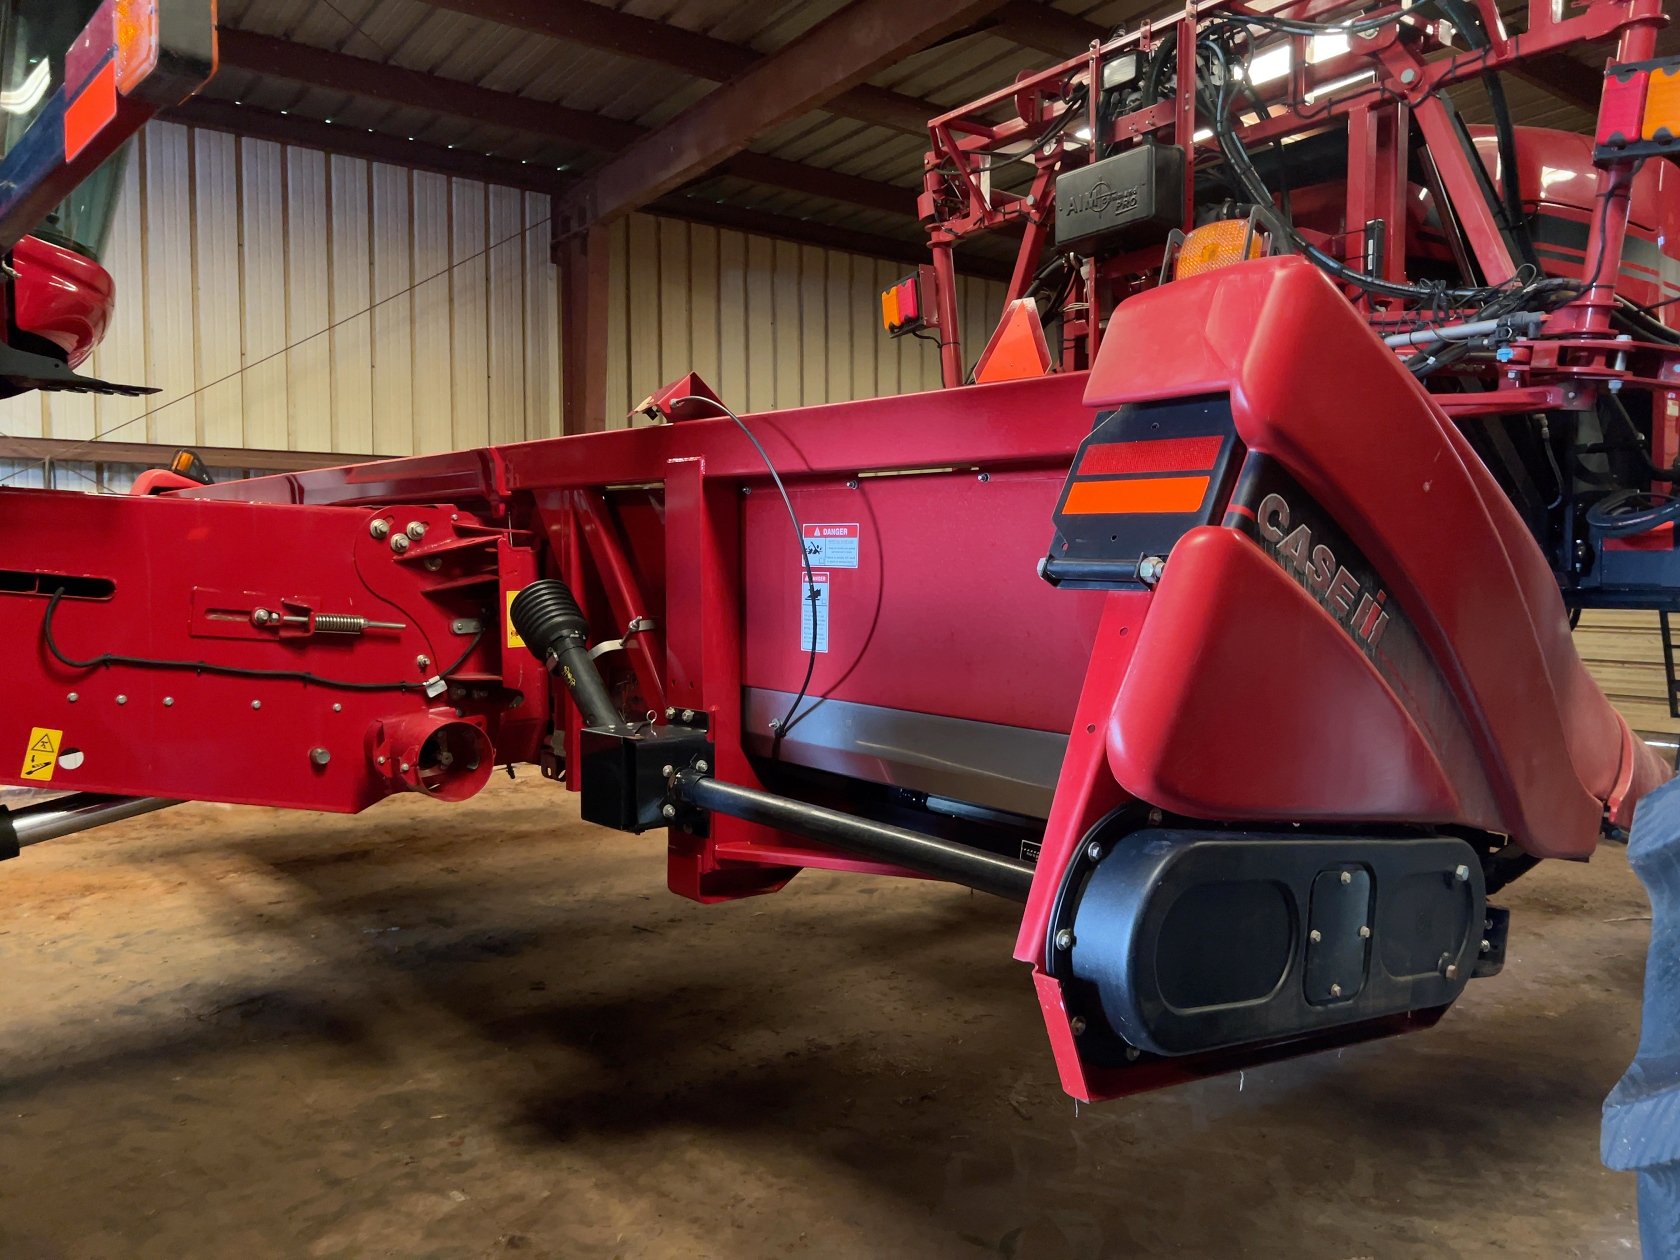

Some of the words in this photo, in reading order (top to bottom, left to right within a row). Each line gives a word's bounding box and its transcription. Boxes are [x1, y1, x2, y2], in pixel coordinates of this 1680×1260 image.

[1066, 188, 1099, 217] AIM
[1115, 195, 1138, 212] PRO
[822, 527, 848, 537] DANGER
[1257, 493, 1361, 618] CASE
